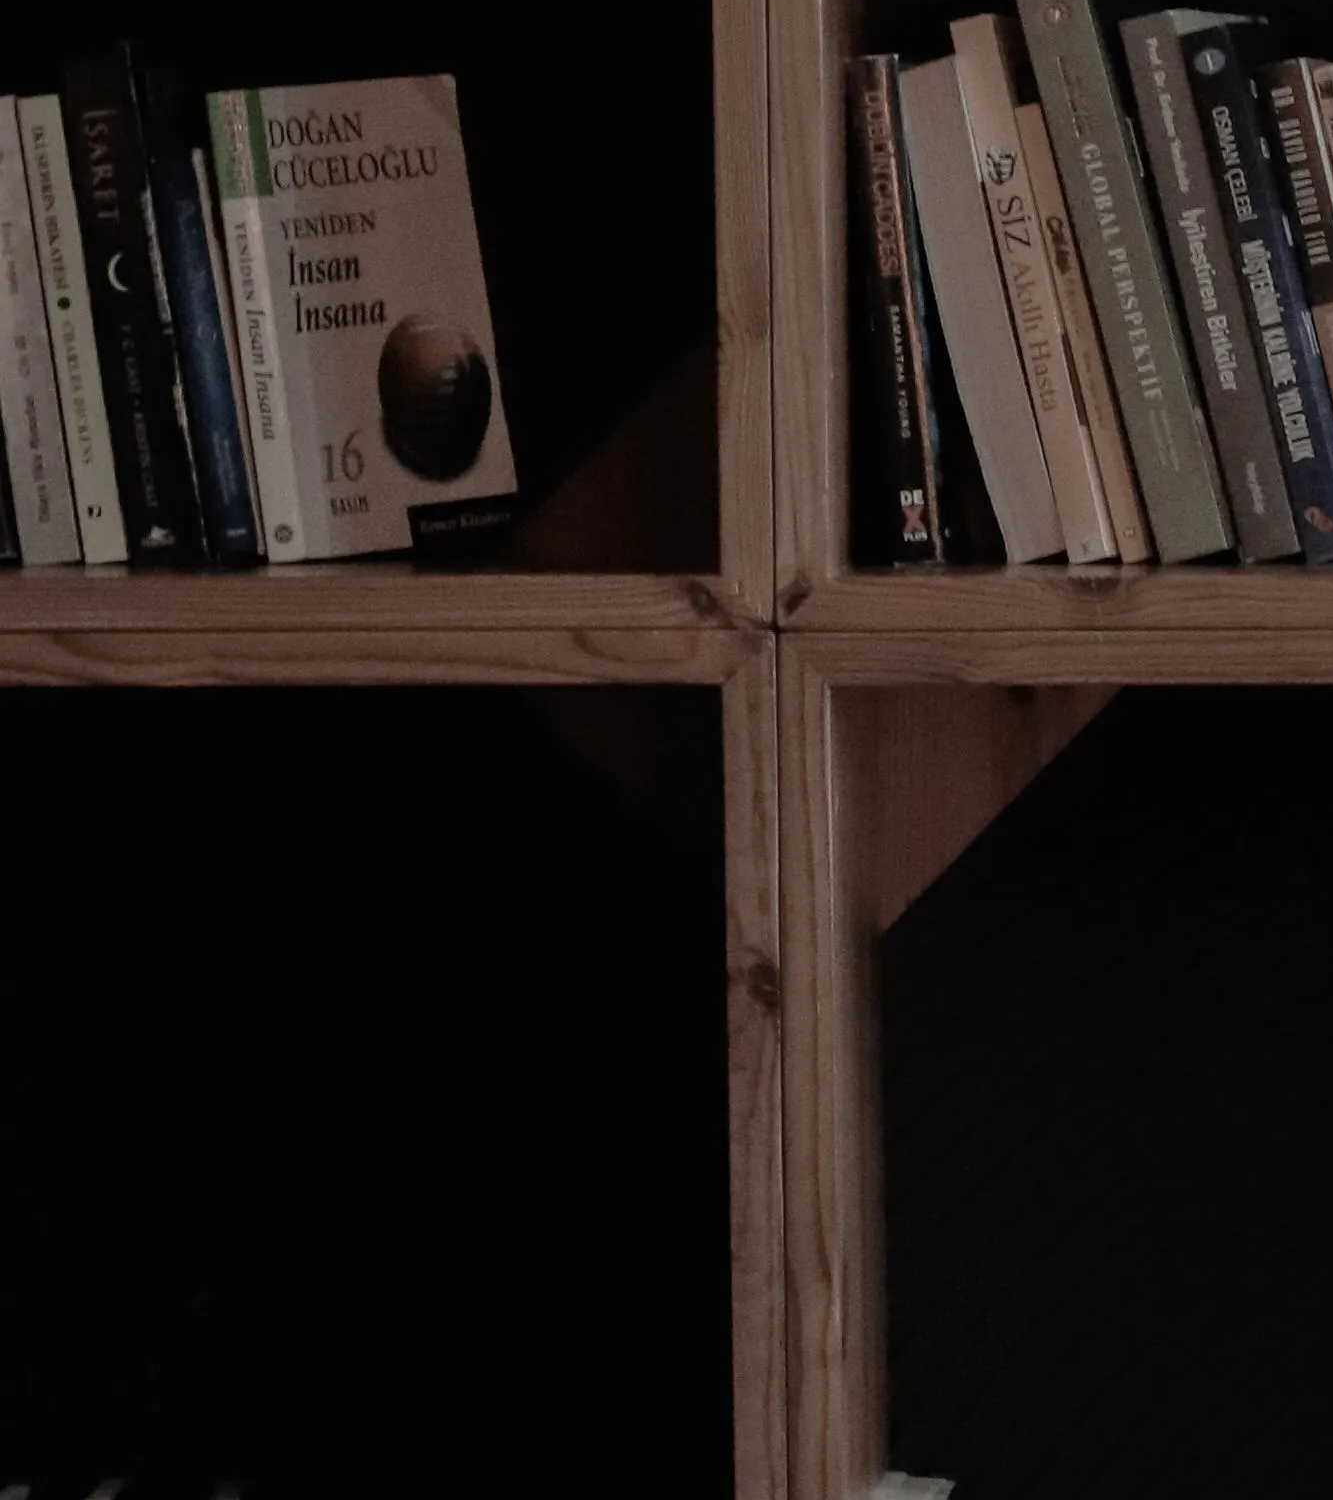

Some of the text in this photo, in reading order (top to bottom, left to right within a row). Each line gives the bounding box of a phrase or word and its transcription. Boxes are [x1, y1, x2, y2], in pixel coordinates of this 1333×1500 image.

[267, 110, 364, 149] DOĞAN
[1211, 106, 1238, 167] OSMAN
[272, 146, 440, 191] CÜCELOĞLU
[1083, 142, 1121, 243] GLOBAL
[280, 208, 378, 241] YENİDEN
[996, 193, 1034, 250] SİZ
[1028, 342, 1057, 413] Hasta
[1178, 208, 1239, 393] İyileştiren Bitkiler
[321, 428, 366, 486] 16
